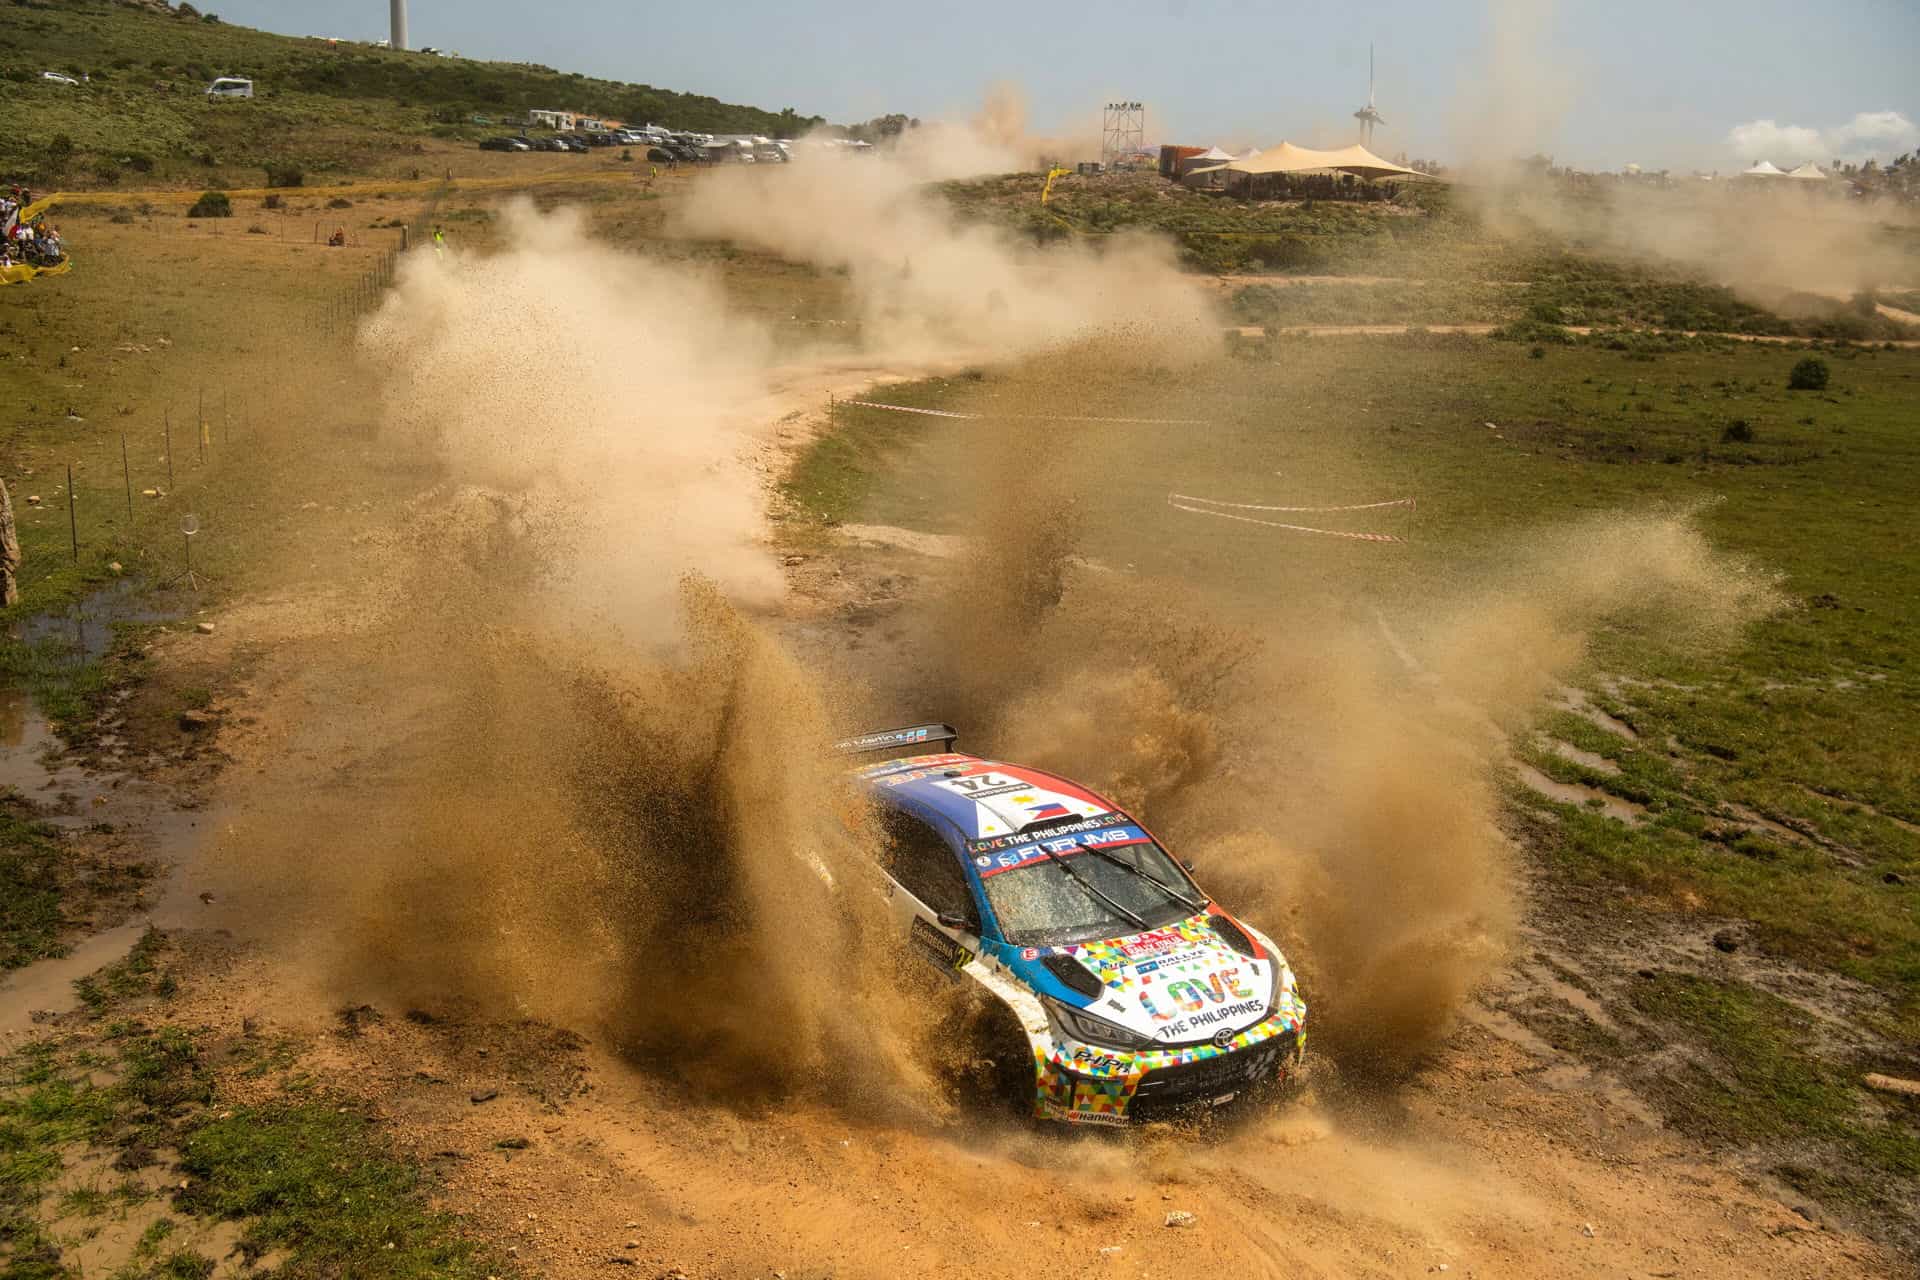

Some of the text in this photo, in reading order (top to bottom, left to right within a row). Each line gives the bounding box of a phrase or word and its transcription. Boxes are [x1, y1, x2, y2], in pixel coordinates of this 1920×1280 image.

[950, 775, 1007, 790] 24
[967, 815, 1129, 853] LOVE THE PHILIPPINES LOVE
[1019, 829, 1130, 860] FORUM8
[1158, 950, 1207, 965] RALLYE
[1138, 967, 1254, 1021] LOVE
[1159, 999, 1264, 1039] THE PHILIPPINES
